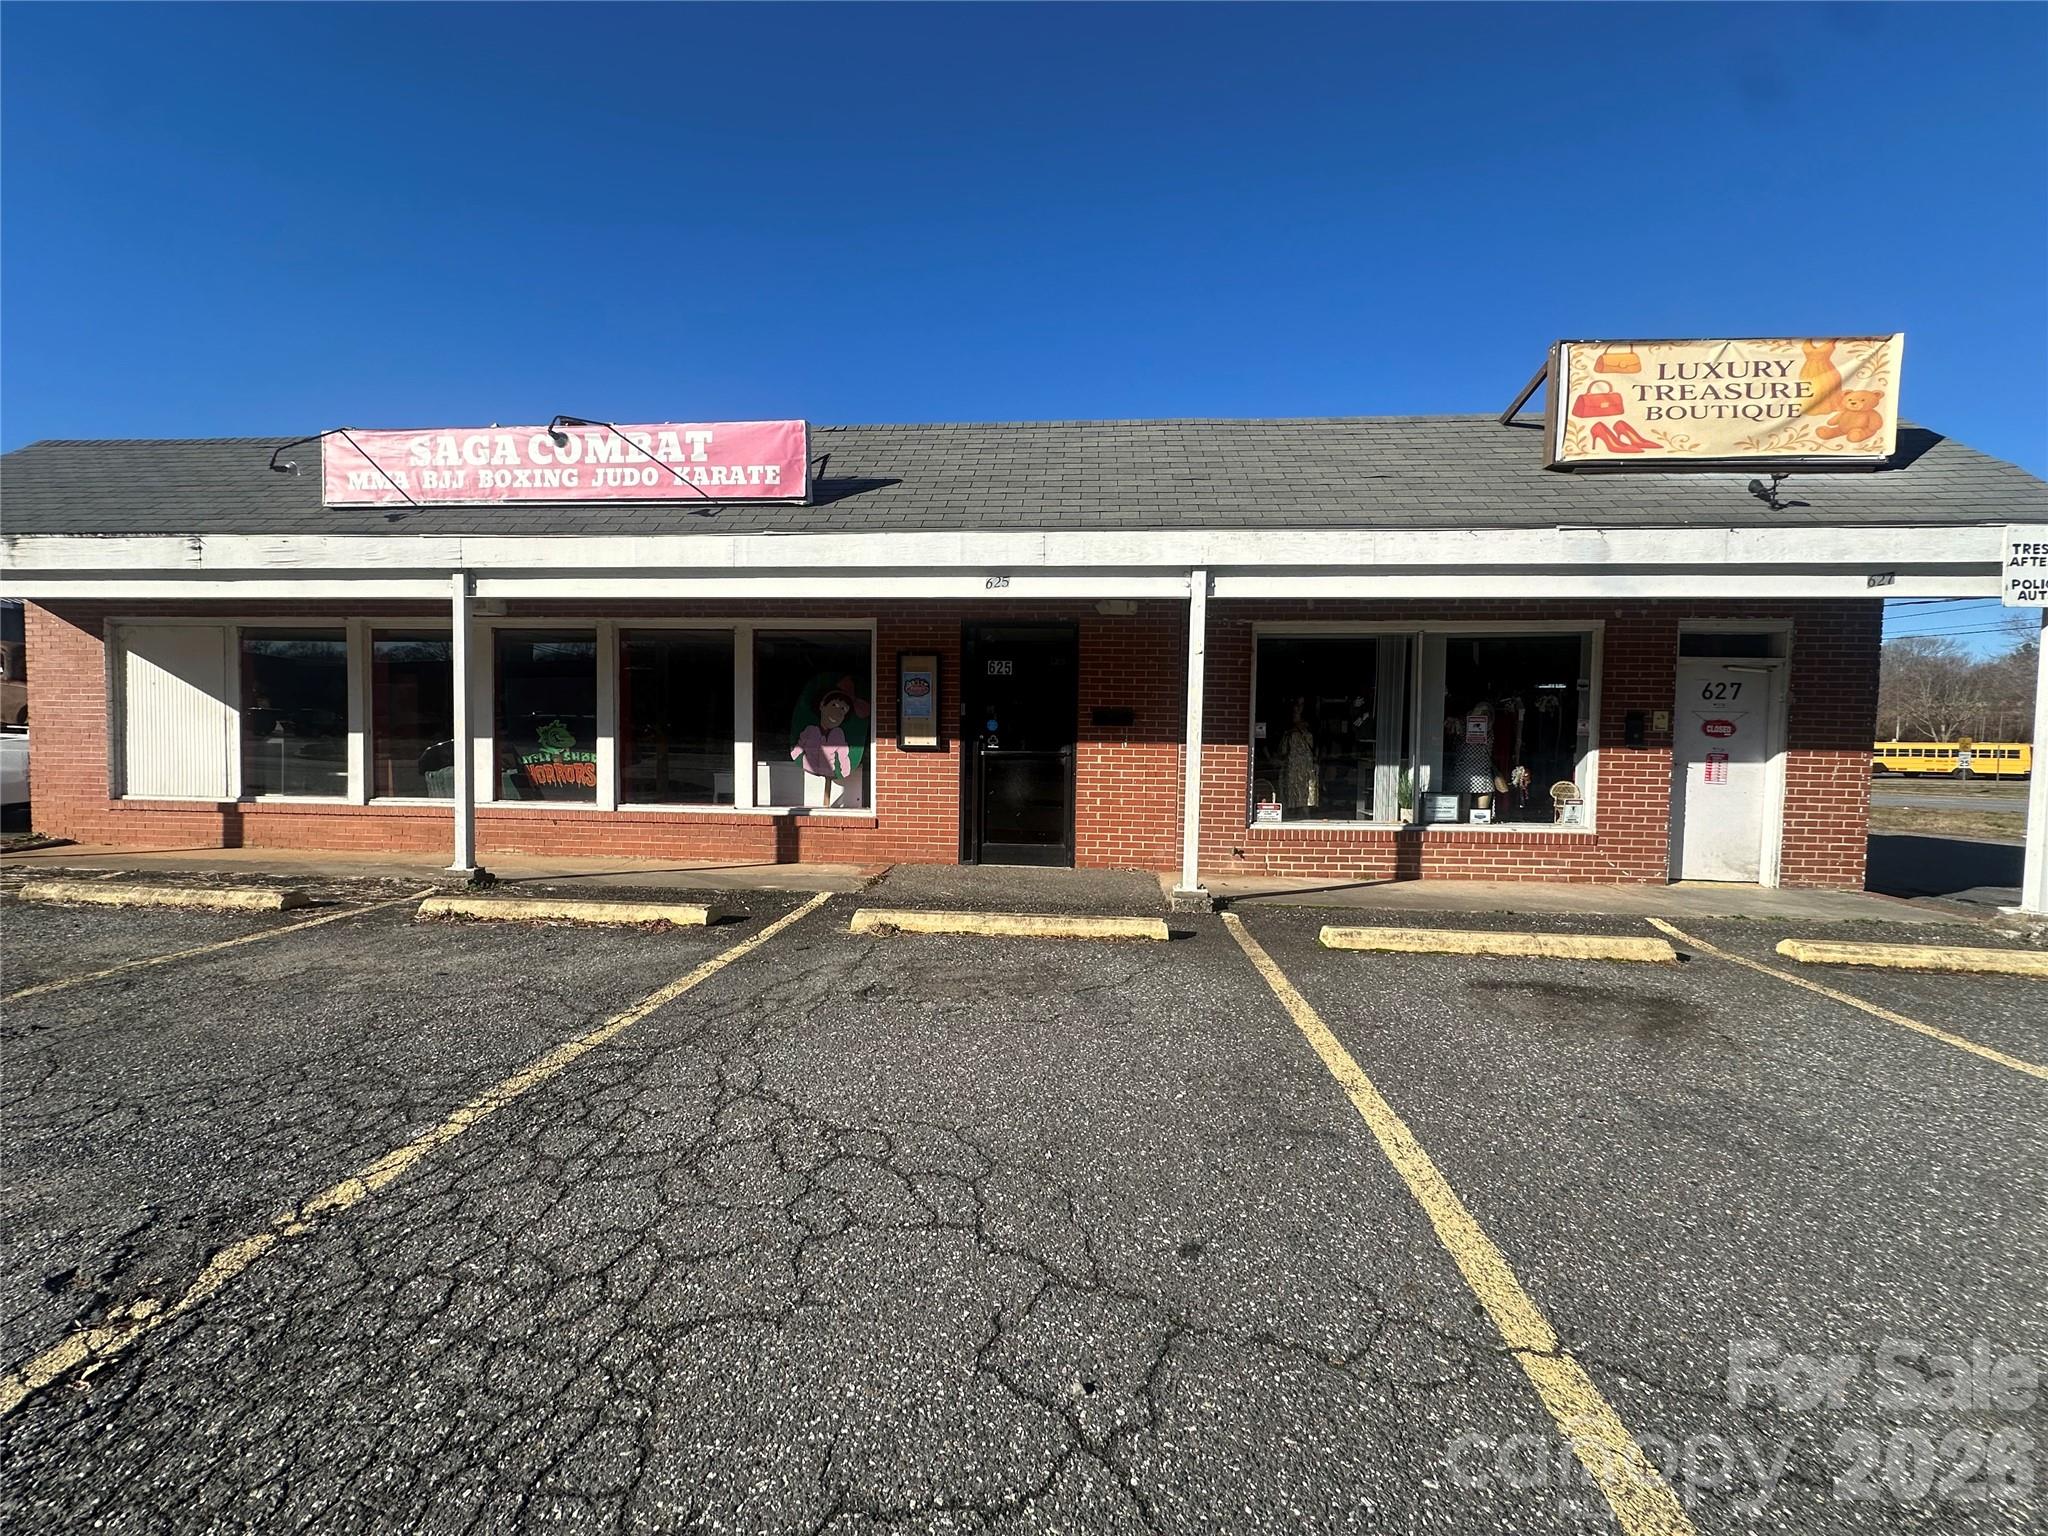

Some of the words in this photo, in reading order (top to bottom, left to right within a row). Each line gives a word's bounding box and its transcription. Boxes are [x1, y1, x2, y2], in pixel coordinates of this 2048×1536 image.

[1656, 359, 1796, 381] LUXURY
[1632, 381, 1815, 402] TREASURE
[1645, 403, 1803, 422] BOUTIQUE
[409, 433, 521, 467] SAGA
[528, 430, 713, 466] COMBAT
[347, 470, 410, 490] MMA
[422, 469, 465, 489] BJJ
[478, 468, 579, 489] BOXING
[591, 467, 659, 488] JUDO
[672, 464, 781, 486] KARATE
[2012, 543, 2048, 555] TRES
[2009, 557, 2047, 567] AFTE
[985, 576, 1010, 590] 625
[1867, 572, 1895, 588] 627
[988, 661, 1013, 675] 625
[1702, 682, 1742, 700] 627
